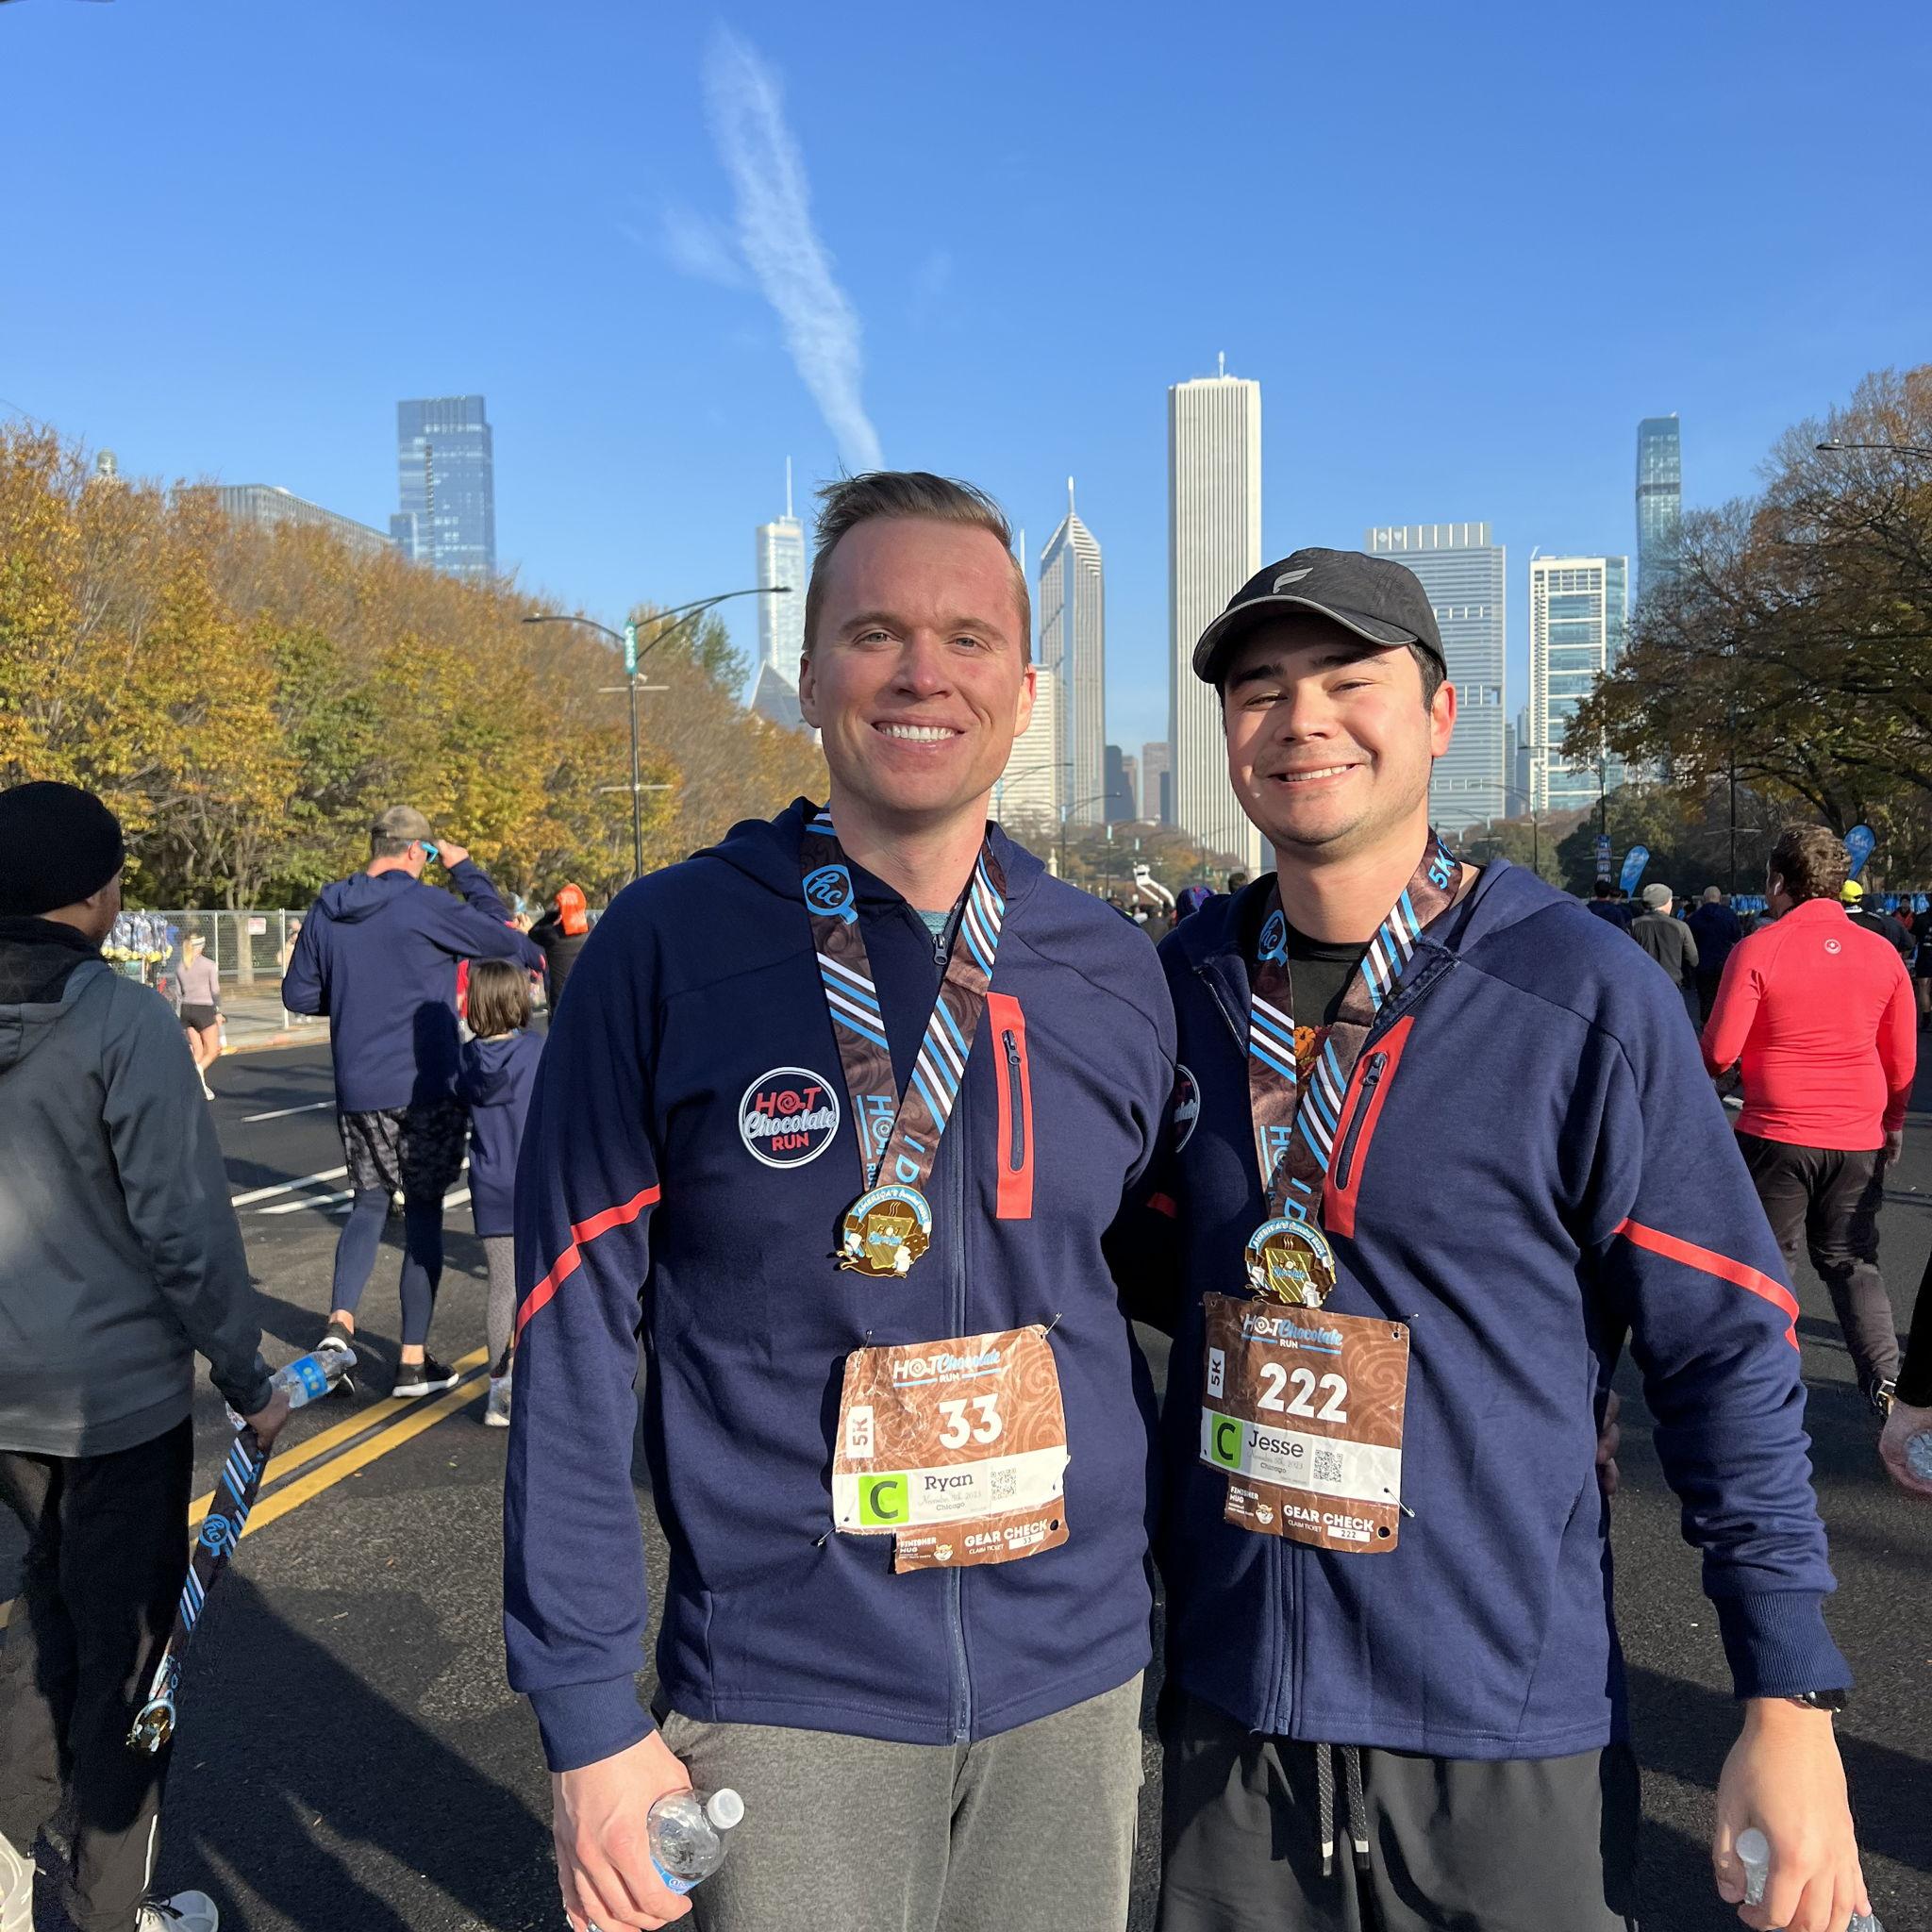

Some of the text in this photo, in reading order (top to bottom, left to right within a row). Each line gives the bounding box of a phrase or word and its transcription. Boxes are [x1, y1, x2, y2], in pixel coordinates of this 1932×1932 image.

[755, 1086, 823, 1117] HOT
[743, 1106, 838, 1140] Chocolate
[772, 1132, 809, 1151] RUN
[1242, 1313, 1344, 1346] HOT Chocolate
[1279, 1339, 1299, 1349] RUN
[892, 1355, 942, 1379] HOT
[940, 1373, 960, 1383] RUN
[1211, 1358, 1222, 1386] 5K
[1257, 1362, 1349, 1424] 222
[852, 1417, 868, 1446] 5K
[938, 1392, 1004, 1449] 33
[1217, 1422, 1237, 1460] C
[1248, 1430, 1305, 1457] Jesse
[924, 1474, 974, 1492] Ryan
[869, 1480, 899, 1520] C
[936, 1502, 965, 1511] Chicago
[964, 1518, 1048, 1547] GEAR CHECK
[1284, 1505, 1374, 1533] GEAR CHECK
[1288, 1519, 1323, 1533] CLAIM TICKET
[1341, 1529, 1357, 1539] 222
[969, 1543, 1005, 1555] CLAIM TICKET
